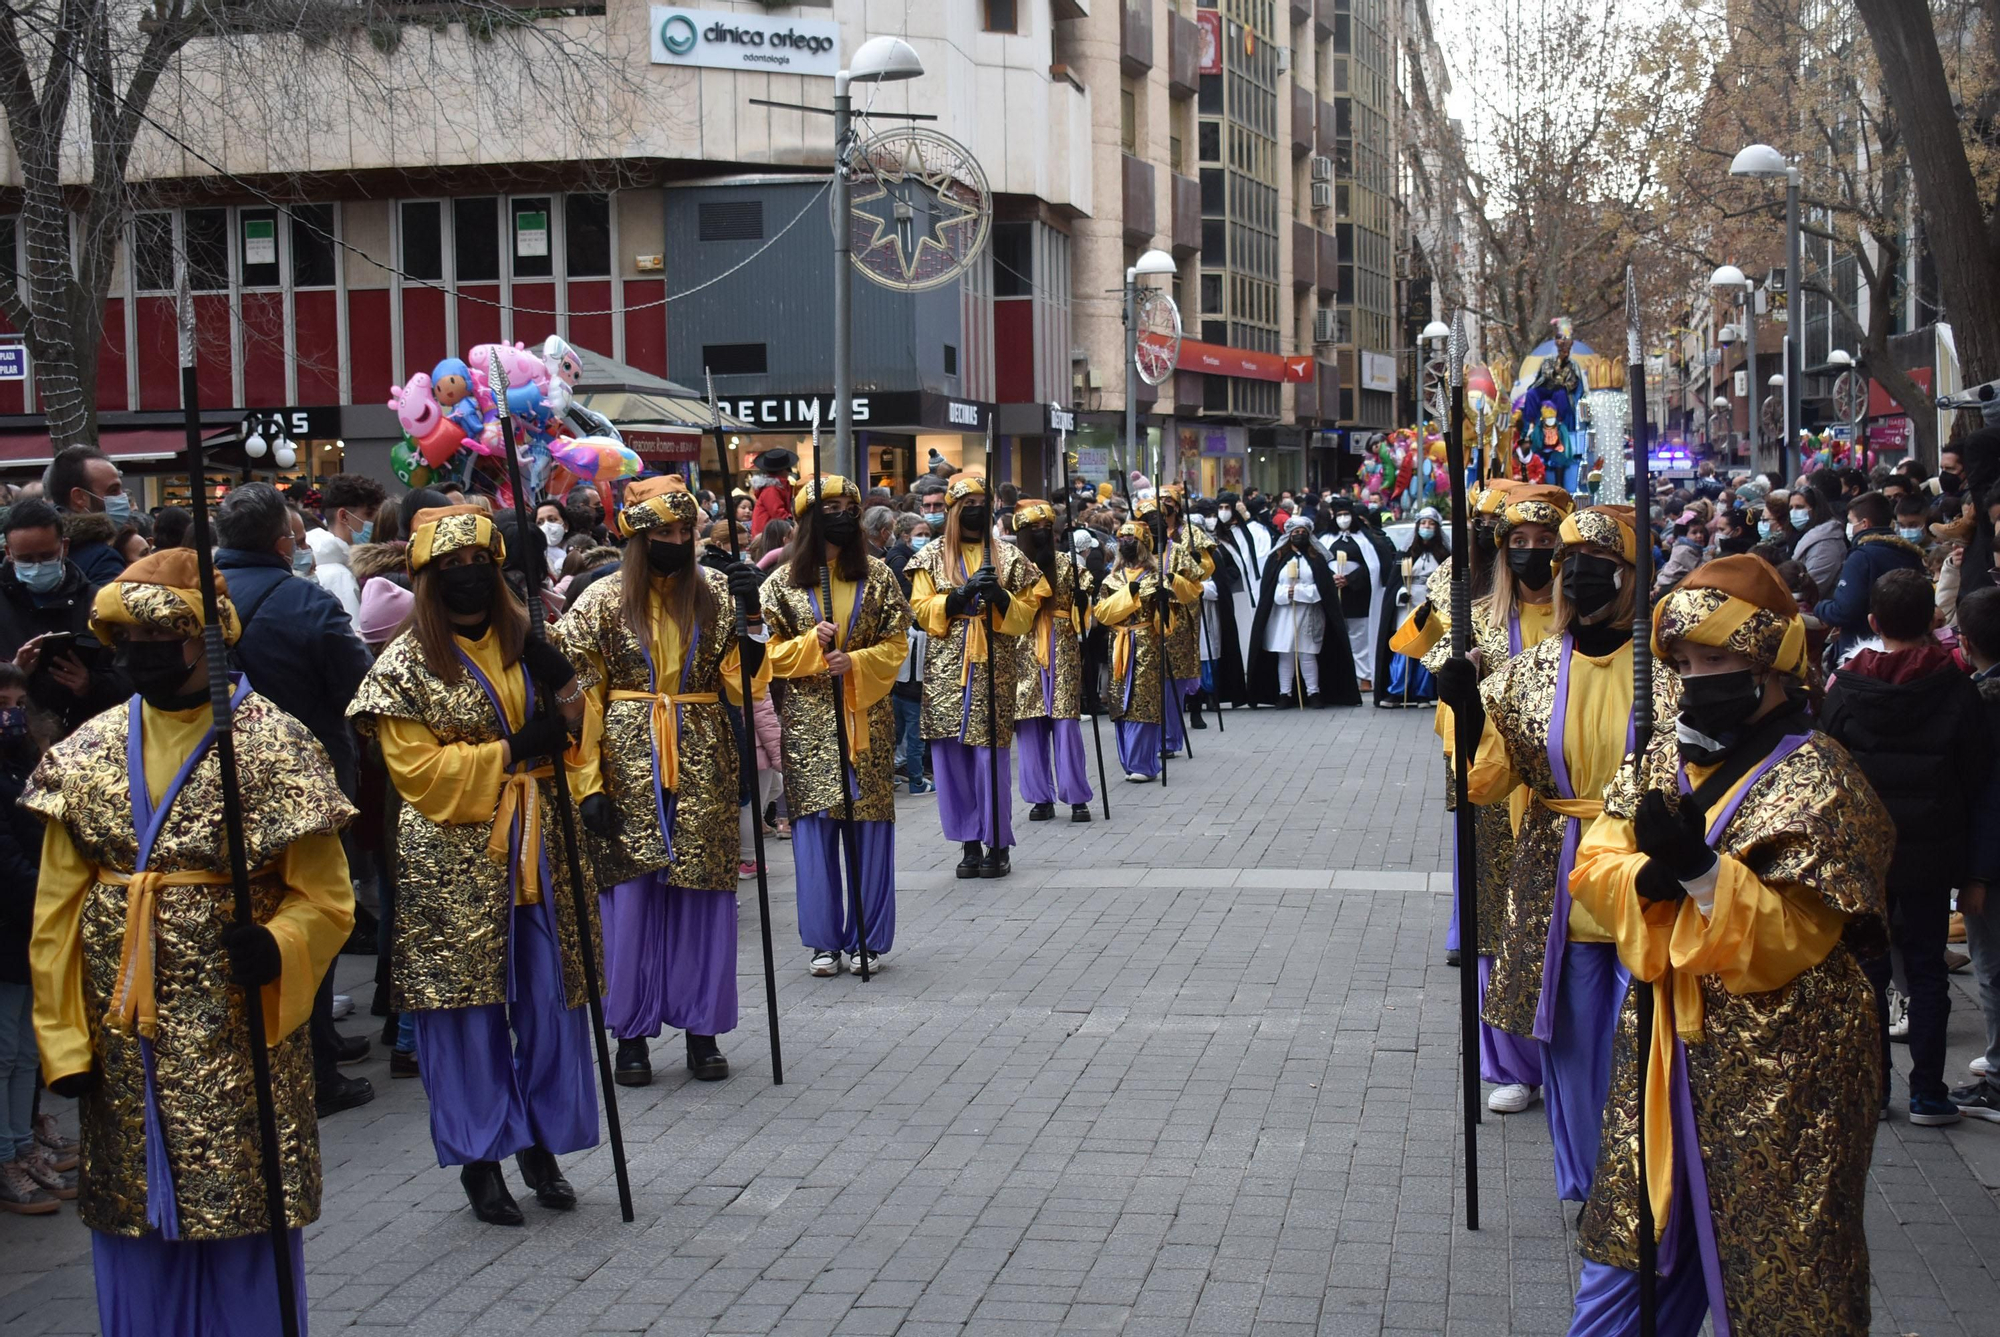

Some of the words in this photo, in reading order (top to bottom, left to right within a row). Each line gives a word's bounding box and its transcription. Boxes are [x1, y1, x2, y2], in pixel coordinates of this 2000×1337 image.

[703, 22, 764, 46] clínica
[769, 28, 833, 54] ortego
[0, 365, 18, 375] PILAR
[949, 402, 978, 425] DECIMAS
